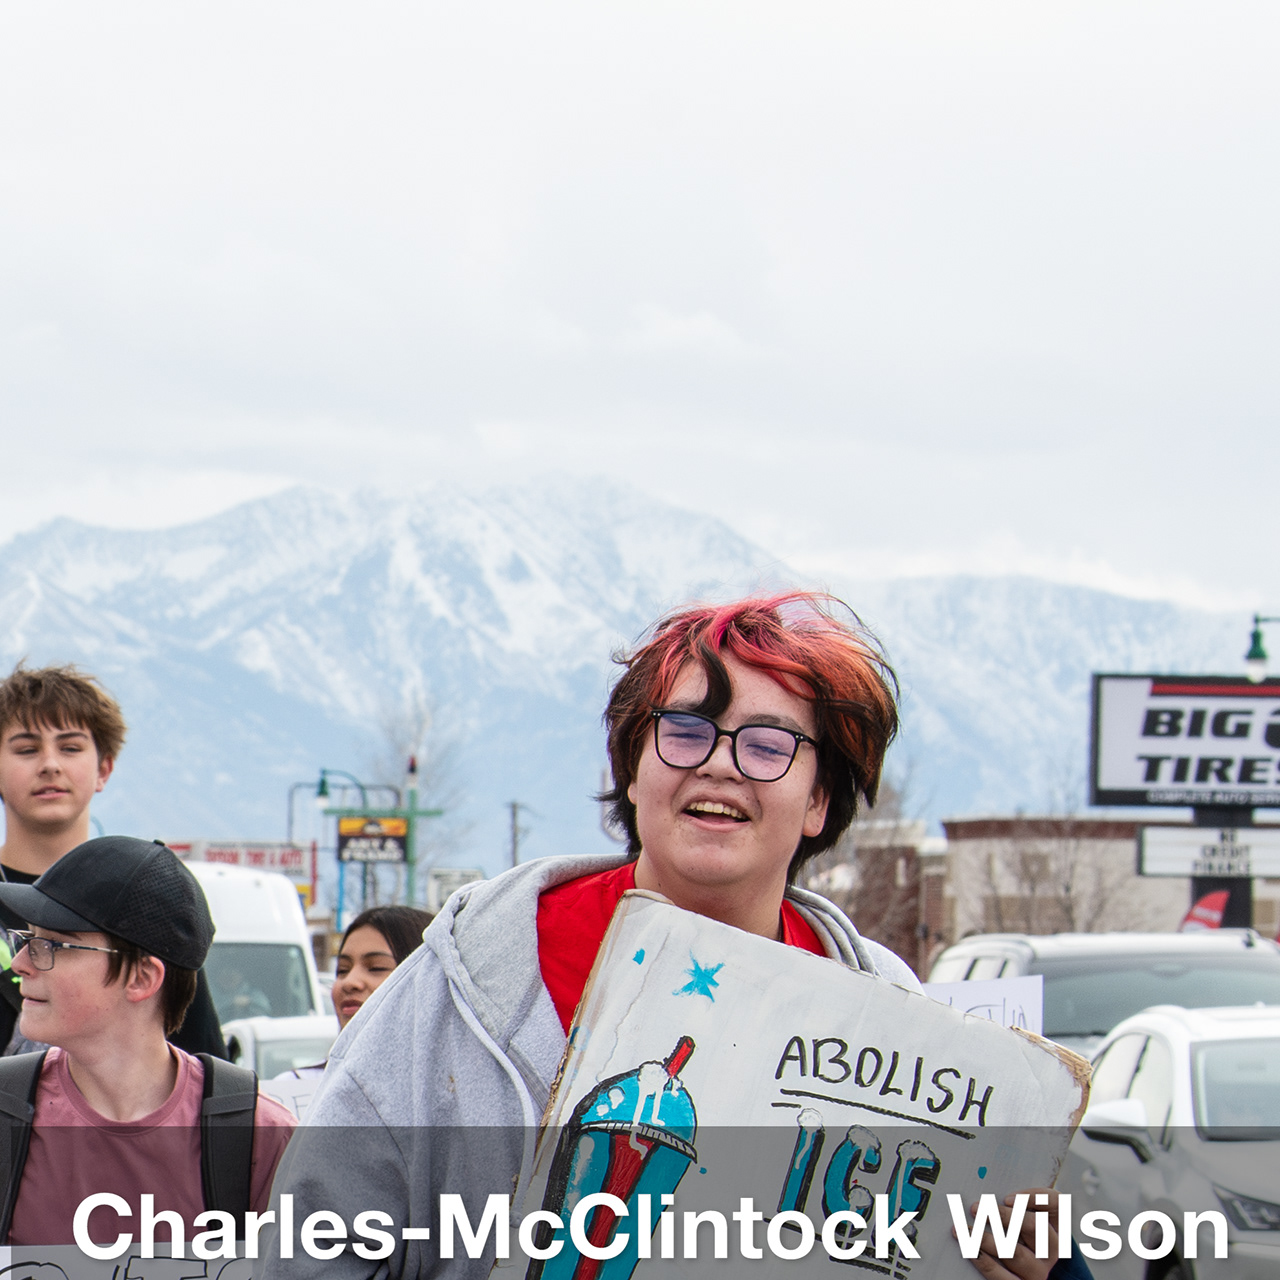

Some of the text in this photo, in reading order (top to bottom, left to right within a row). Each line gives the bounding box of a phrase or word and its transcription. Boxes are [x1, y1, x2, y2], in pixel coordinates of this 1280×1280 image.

[1141, 709, 1255, 738] BIG
[1137, 756, 1280, 784] TIRE
[775, 1036, 994, 1127] ABOLISH
[777, 1108, 941, 1260] ICE
